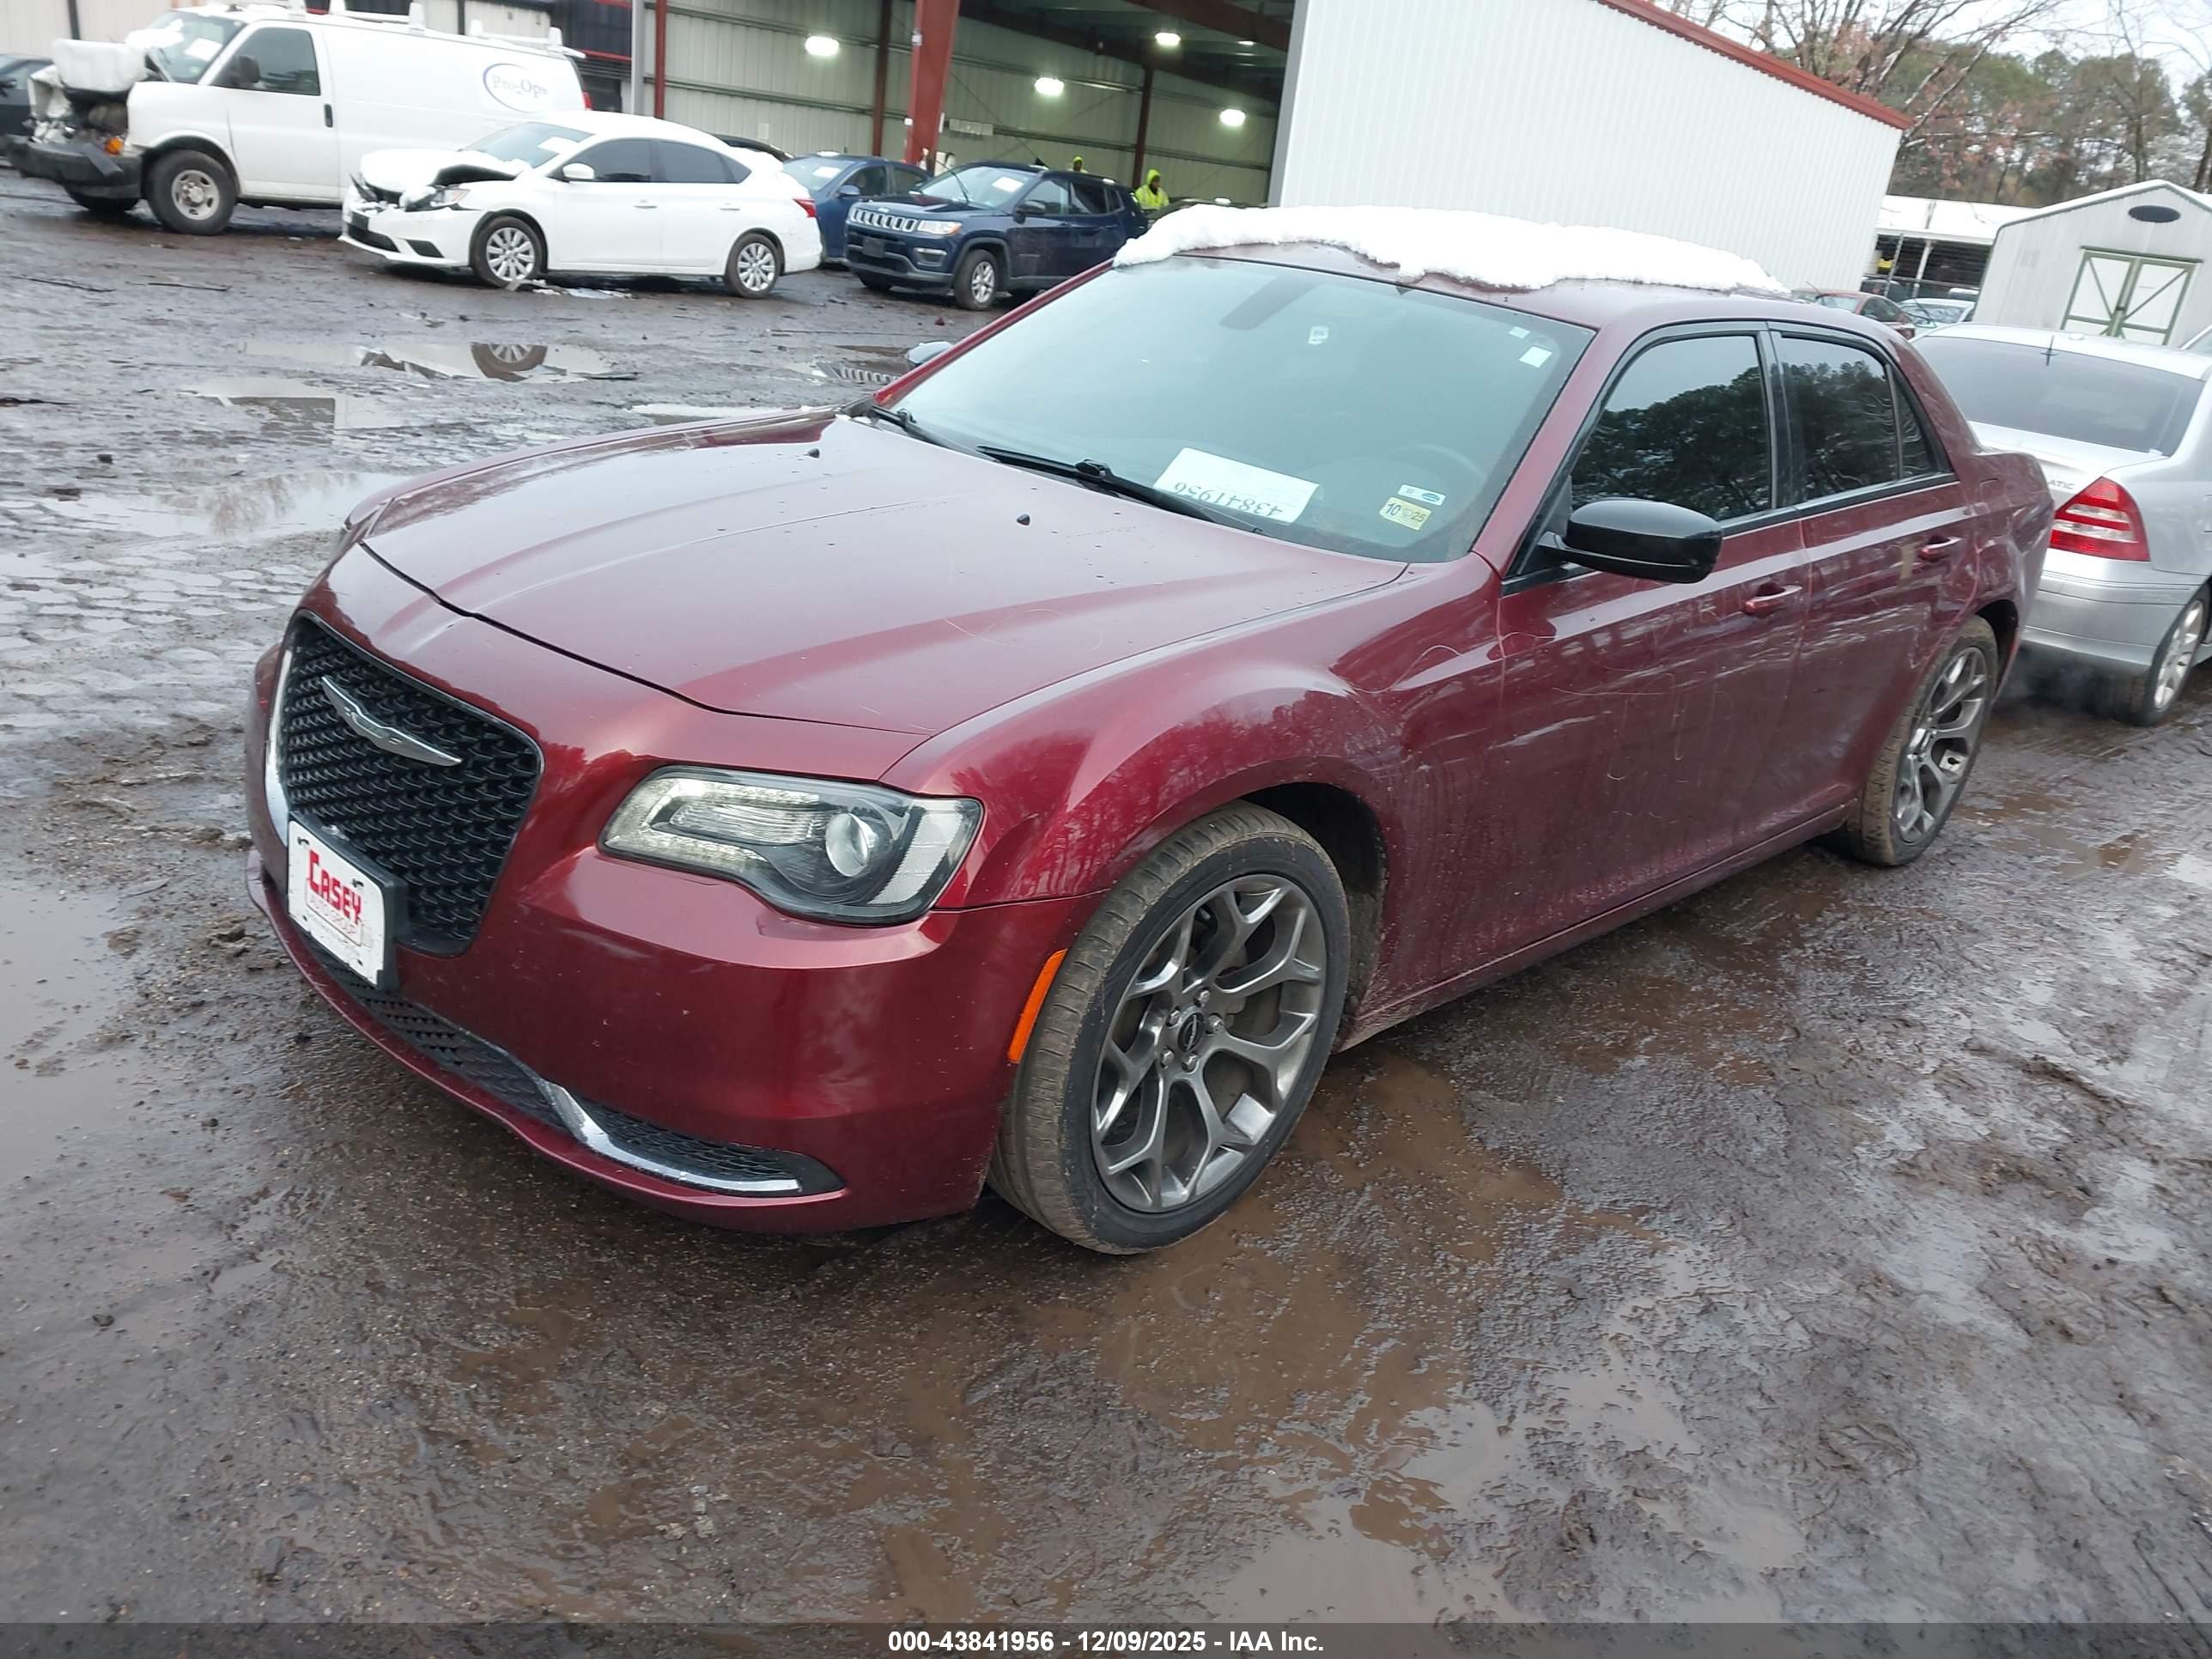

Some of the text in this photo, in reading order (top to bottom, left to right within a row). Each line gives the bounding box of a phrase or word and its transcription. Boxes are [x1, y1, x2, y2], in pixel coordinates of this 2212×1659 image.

[1174, 482, 1283, 516] 43841956
[1386, 503, 1427, 523] 10 25
[309, 850, 362, 925] CASEY
